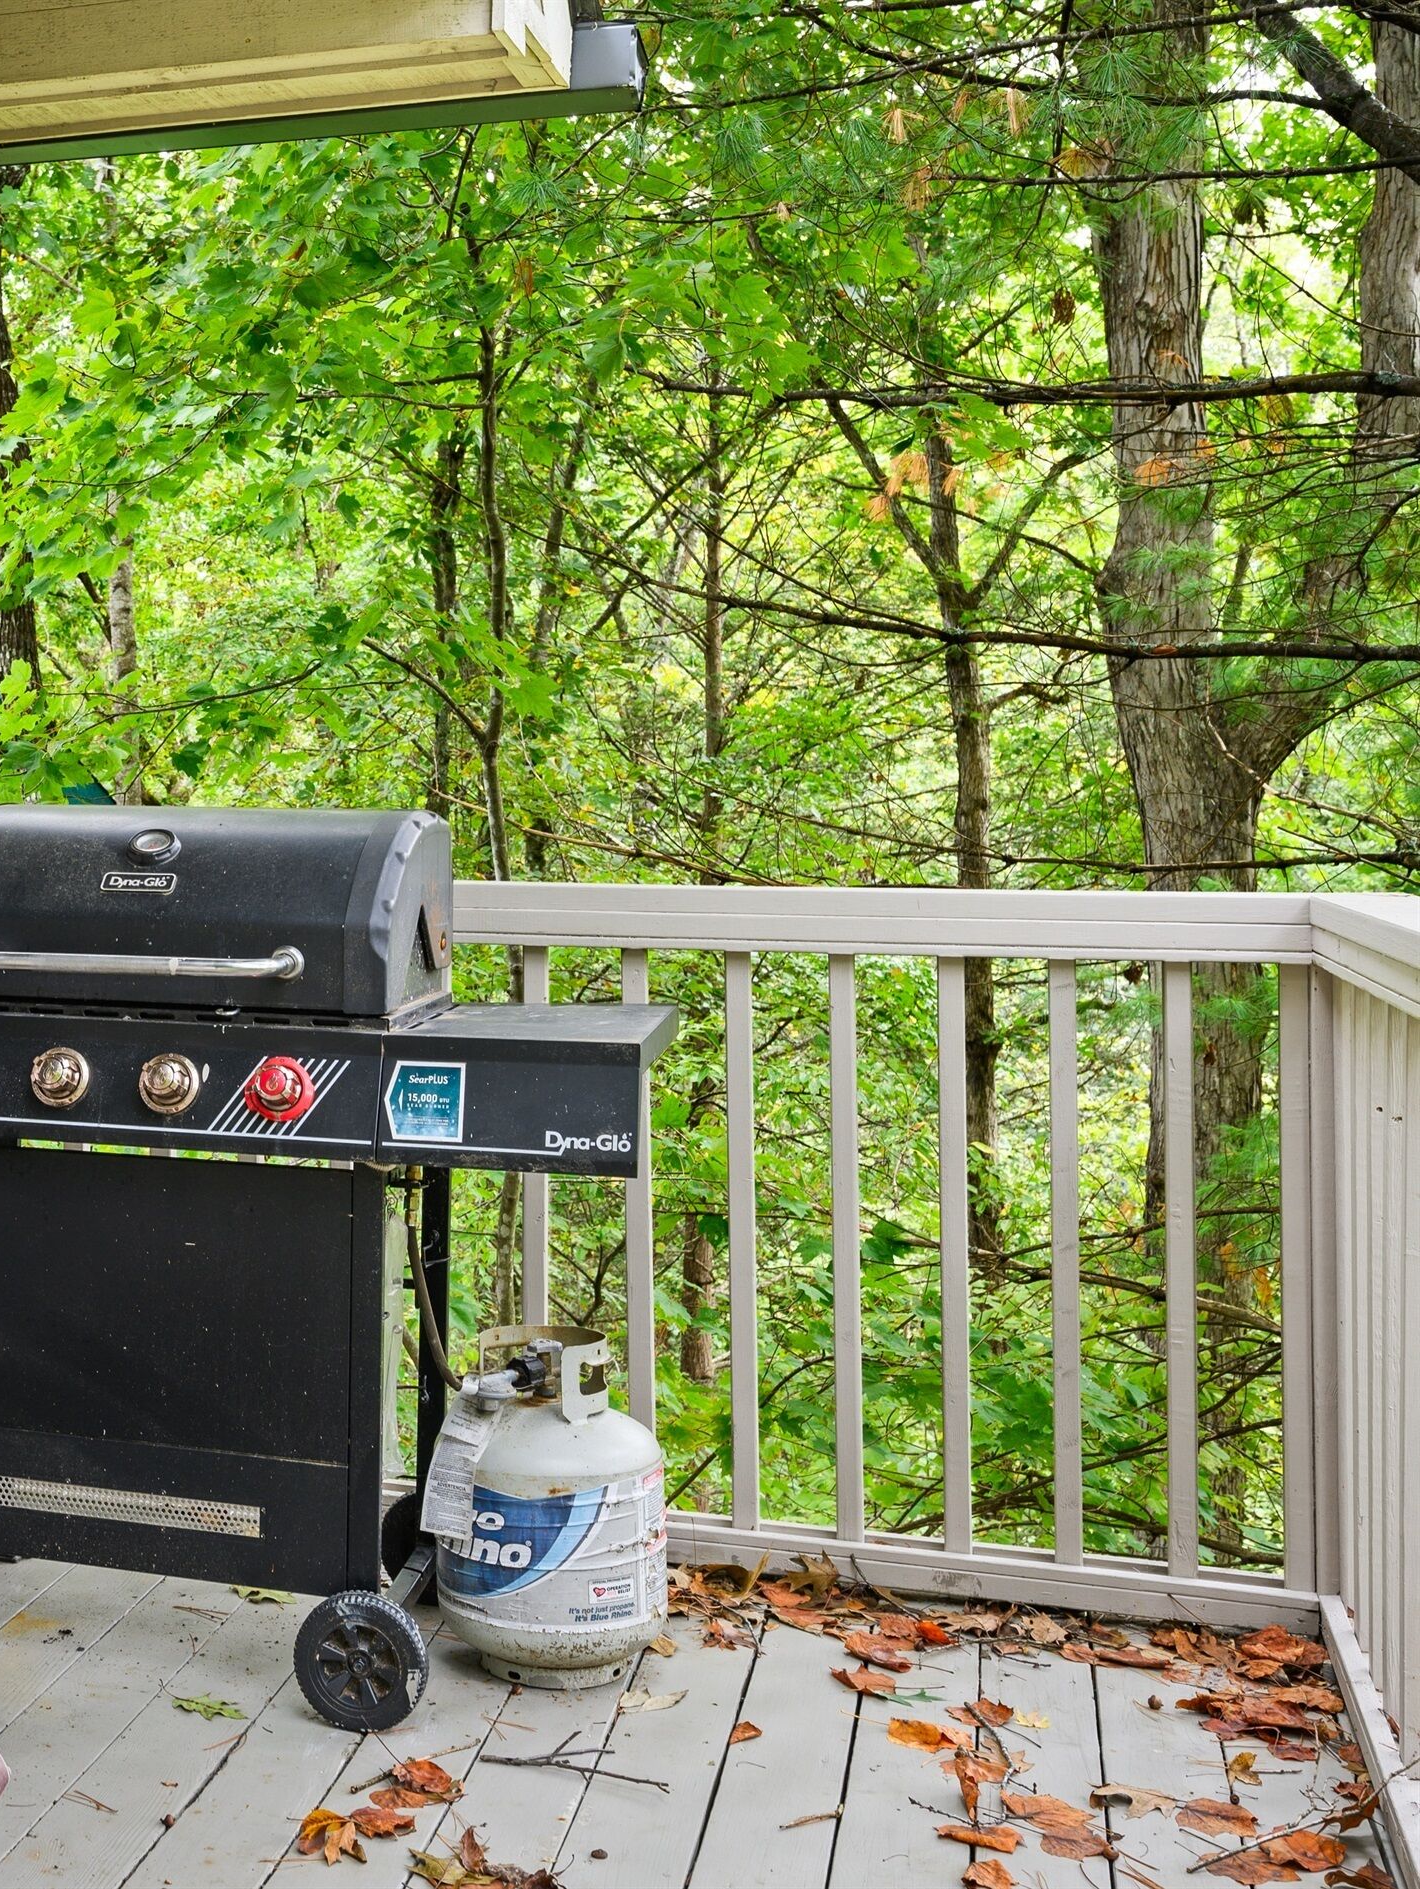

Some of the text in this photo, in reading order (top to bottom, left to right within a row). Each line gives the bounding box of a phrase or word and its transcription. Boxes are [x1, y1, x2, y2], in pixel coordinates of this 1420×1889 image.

[109, 876, 167, 888] Dyna-Glo
[408, 1093, 437, 1103] 15,000
[545, 1130, 631, 1156] Dyna-Glo
[595, 1605, 608, 1613] just
[575, 1614, 587, 1622] It's
[590, 1613, 609, 1621] Blue
